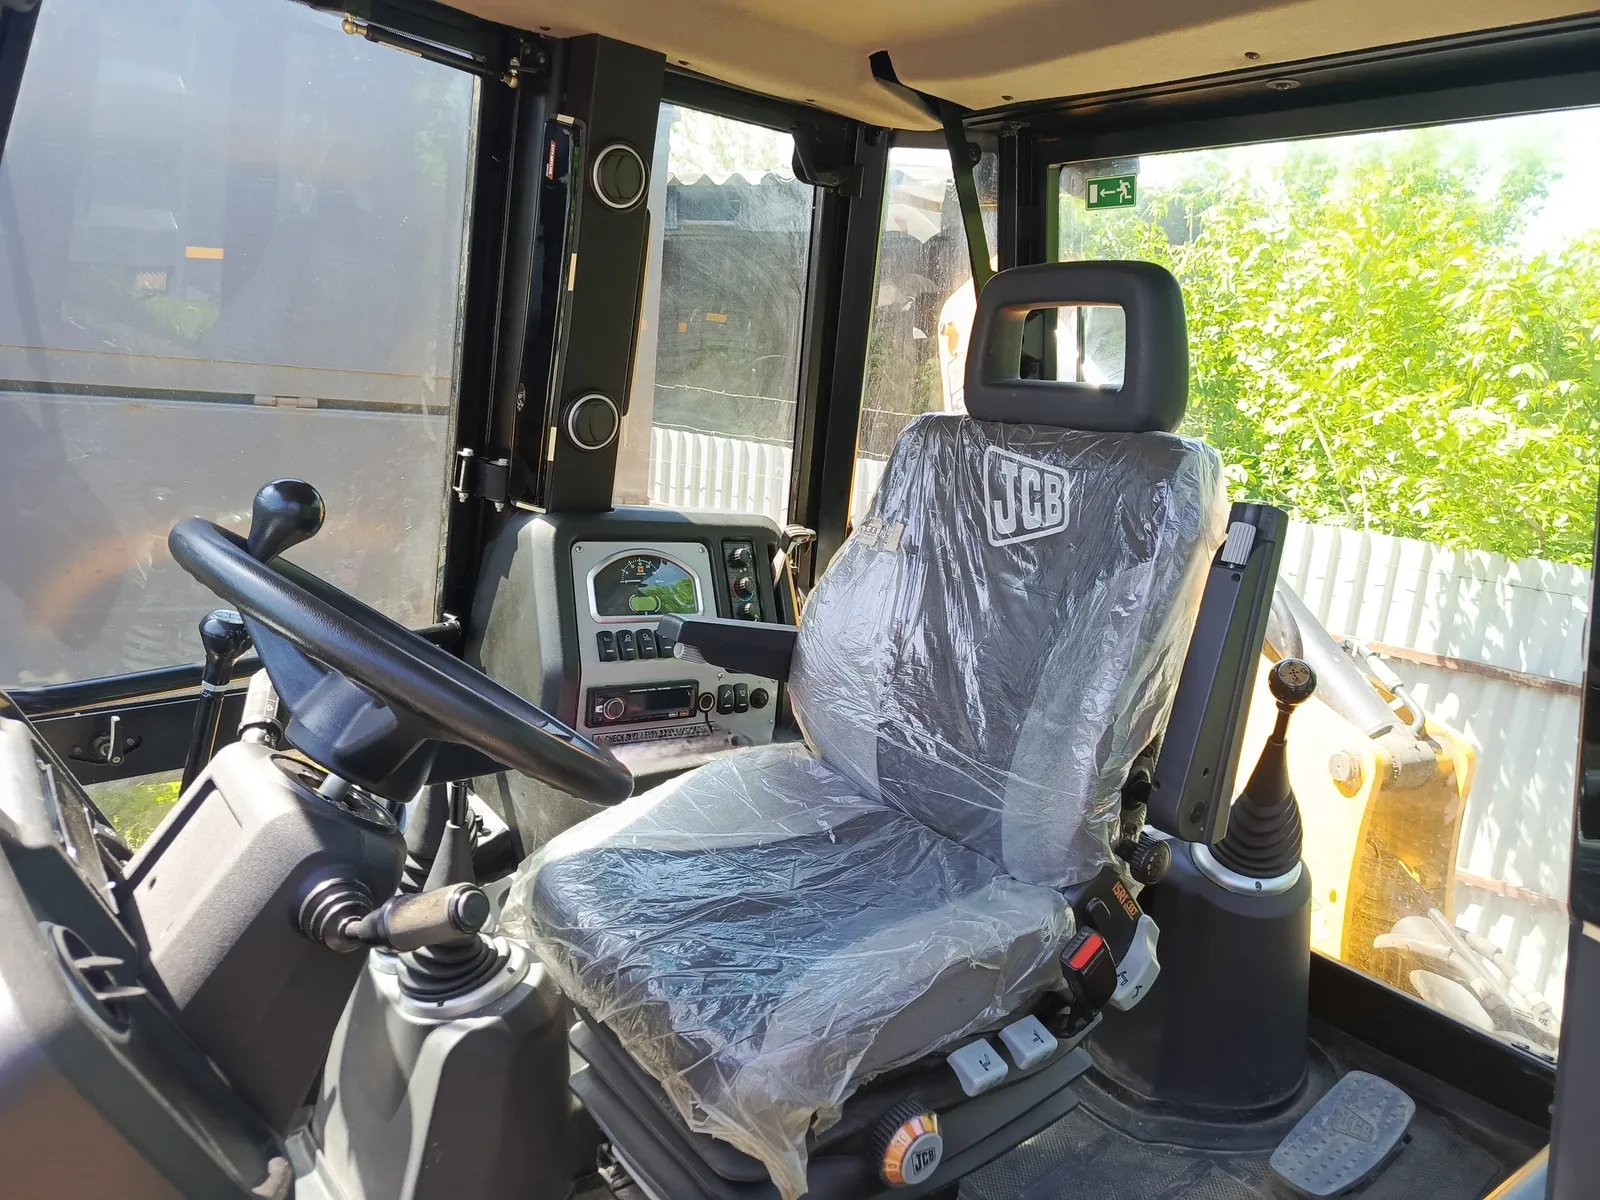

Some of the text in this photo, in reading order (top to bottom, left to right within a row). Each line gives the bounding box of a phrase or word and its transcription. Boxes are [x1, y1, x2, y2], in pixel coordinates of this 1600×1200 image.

[994, 459, 1062, 534] JCB
[605, 733, 624, 742] CHECK
[1112, 881, 1128, 905] ISRI
[914, 1150, 935, 1172] JCB
